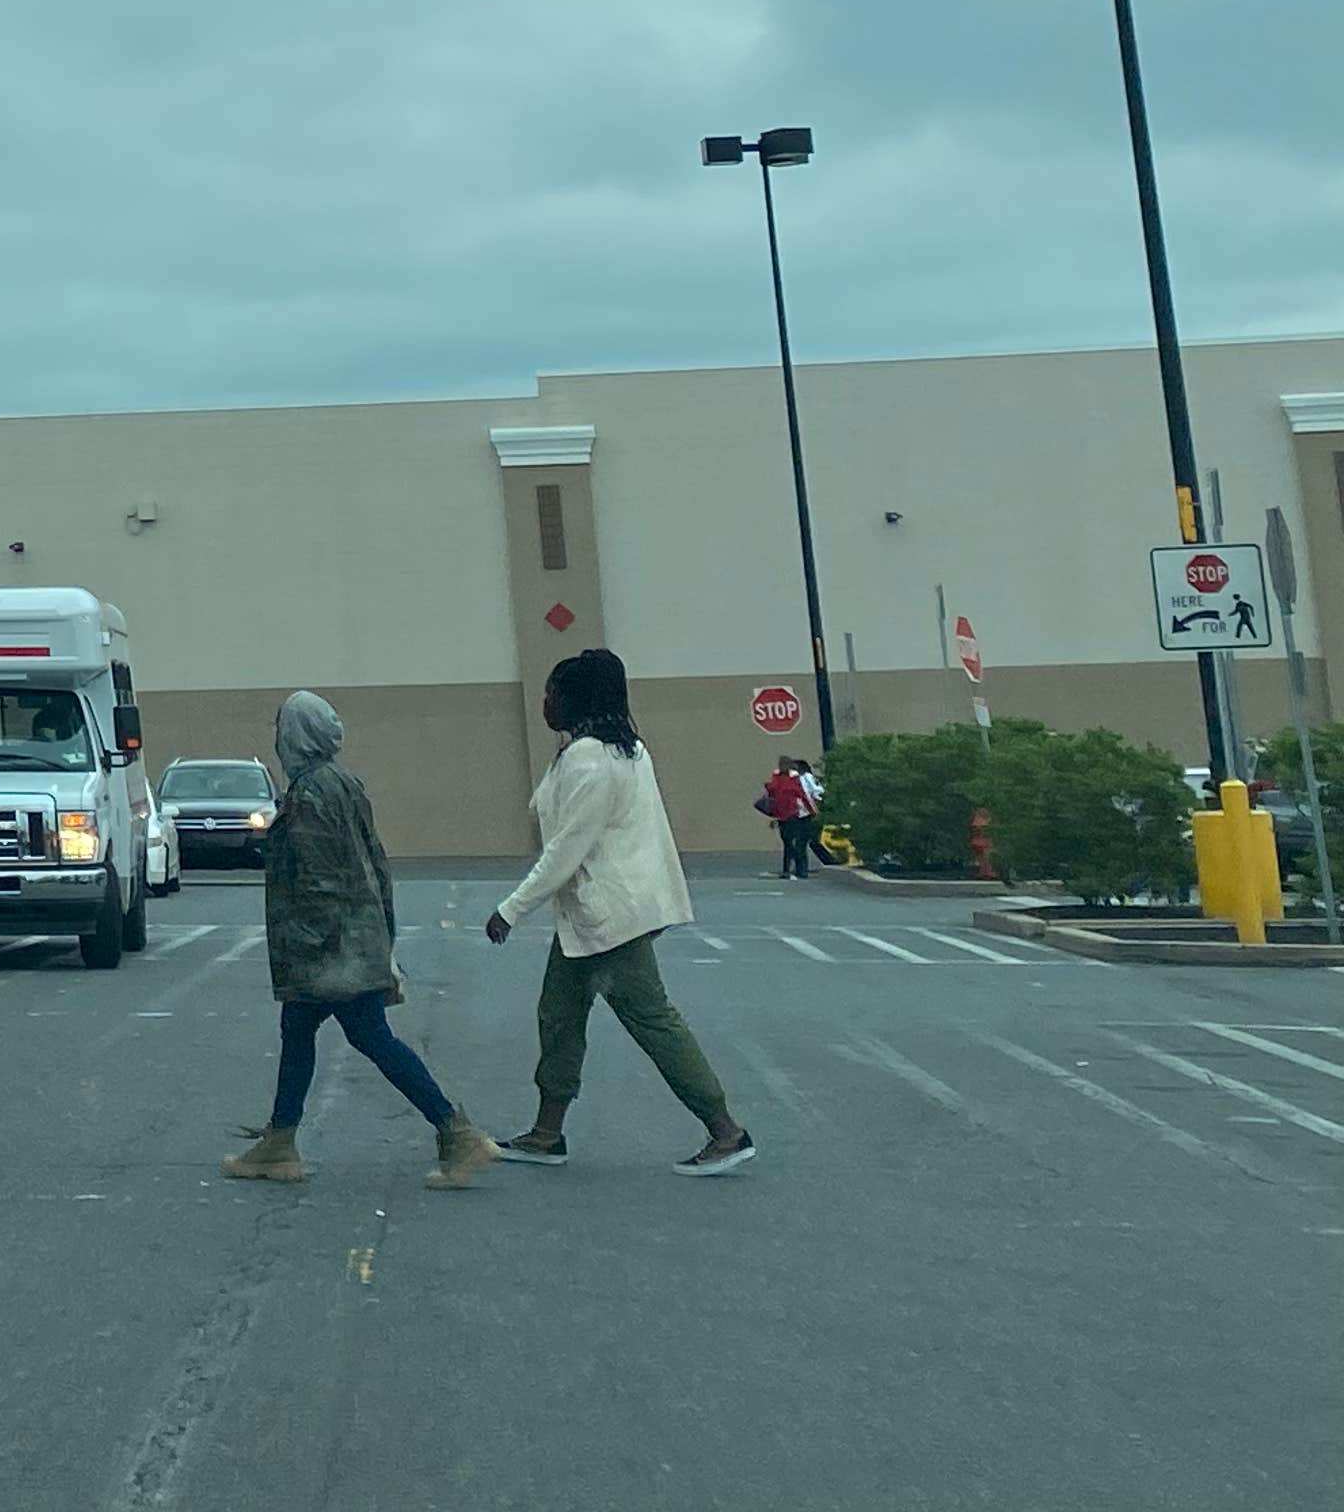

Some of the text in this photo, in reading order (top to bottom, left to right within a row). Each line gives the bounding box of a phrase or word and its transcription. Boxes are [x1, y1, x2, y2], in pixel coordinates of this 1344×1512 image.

[1187, 565, 1228, 583] STOP
[1171, 595, 1205, 608] HERE
[1201, 621, 1227, 633] FOR
[755, 701, 797, 720] STOP
